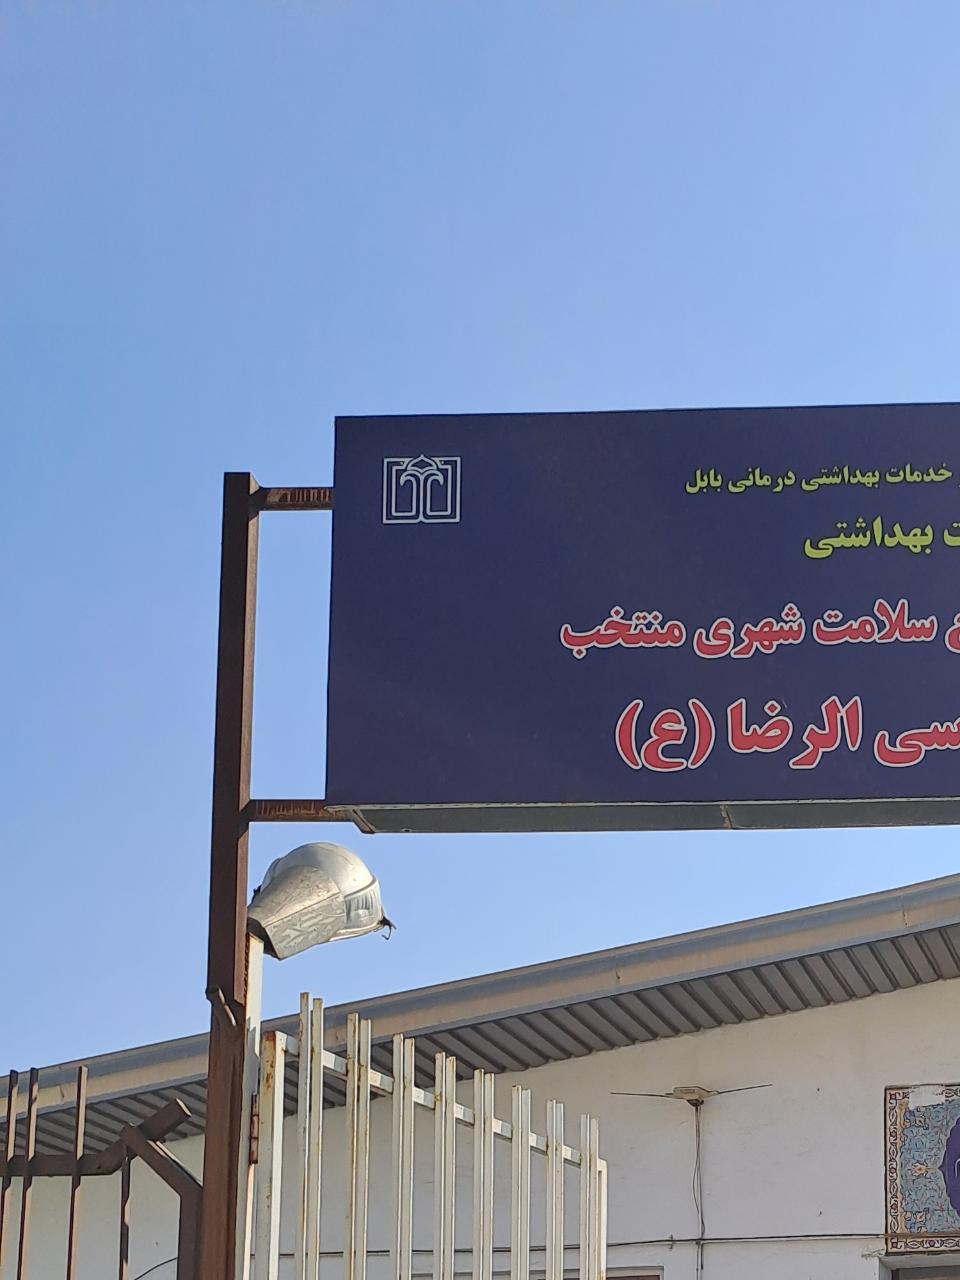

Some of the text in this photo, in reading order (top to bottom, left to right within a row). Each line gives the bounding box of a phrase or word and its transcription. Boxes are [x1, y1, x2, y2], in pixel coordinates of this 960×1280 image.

[684, 468, 723, 494] بابل
[727, 468, 796, 494] درمانی
[800, 466, 880, 492] بهداشتی
[884, 463, 952, 484] خدمات
[803, 515, 934, 560] بهداشتی
[560, 606, 687, 659] منتخب
[693, 603, 806, 659] شهری
[813, 598, 938, 645] سلامت
[615, 698, 716, 772] (ع)
[727, 695, 863, 769] الرضا
